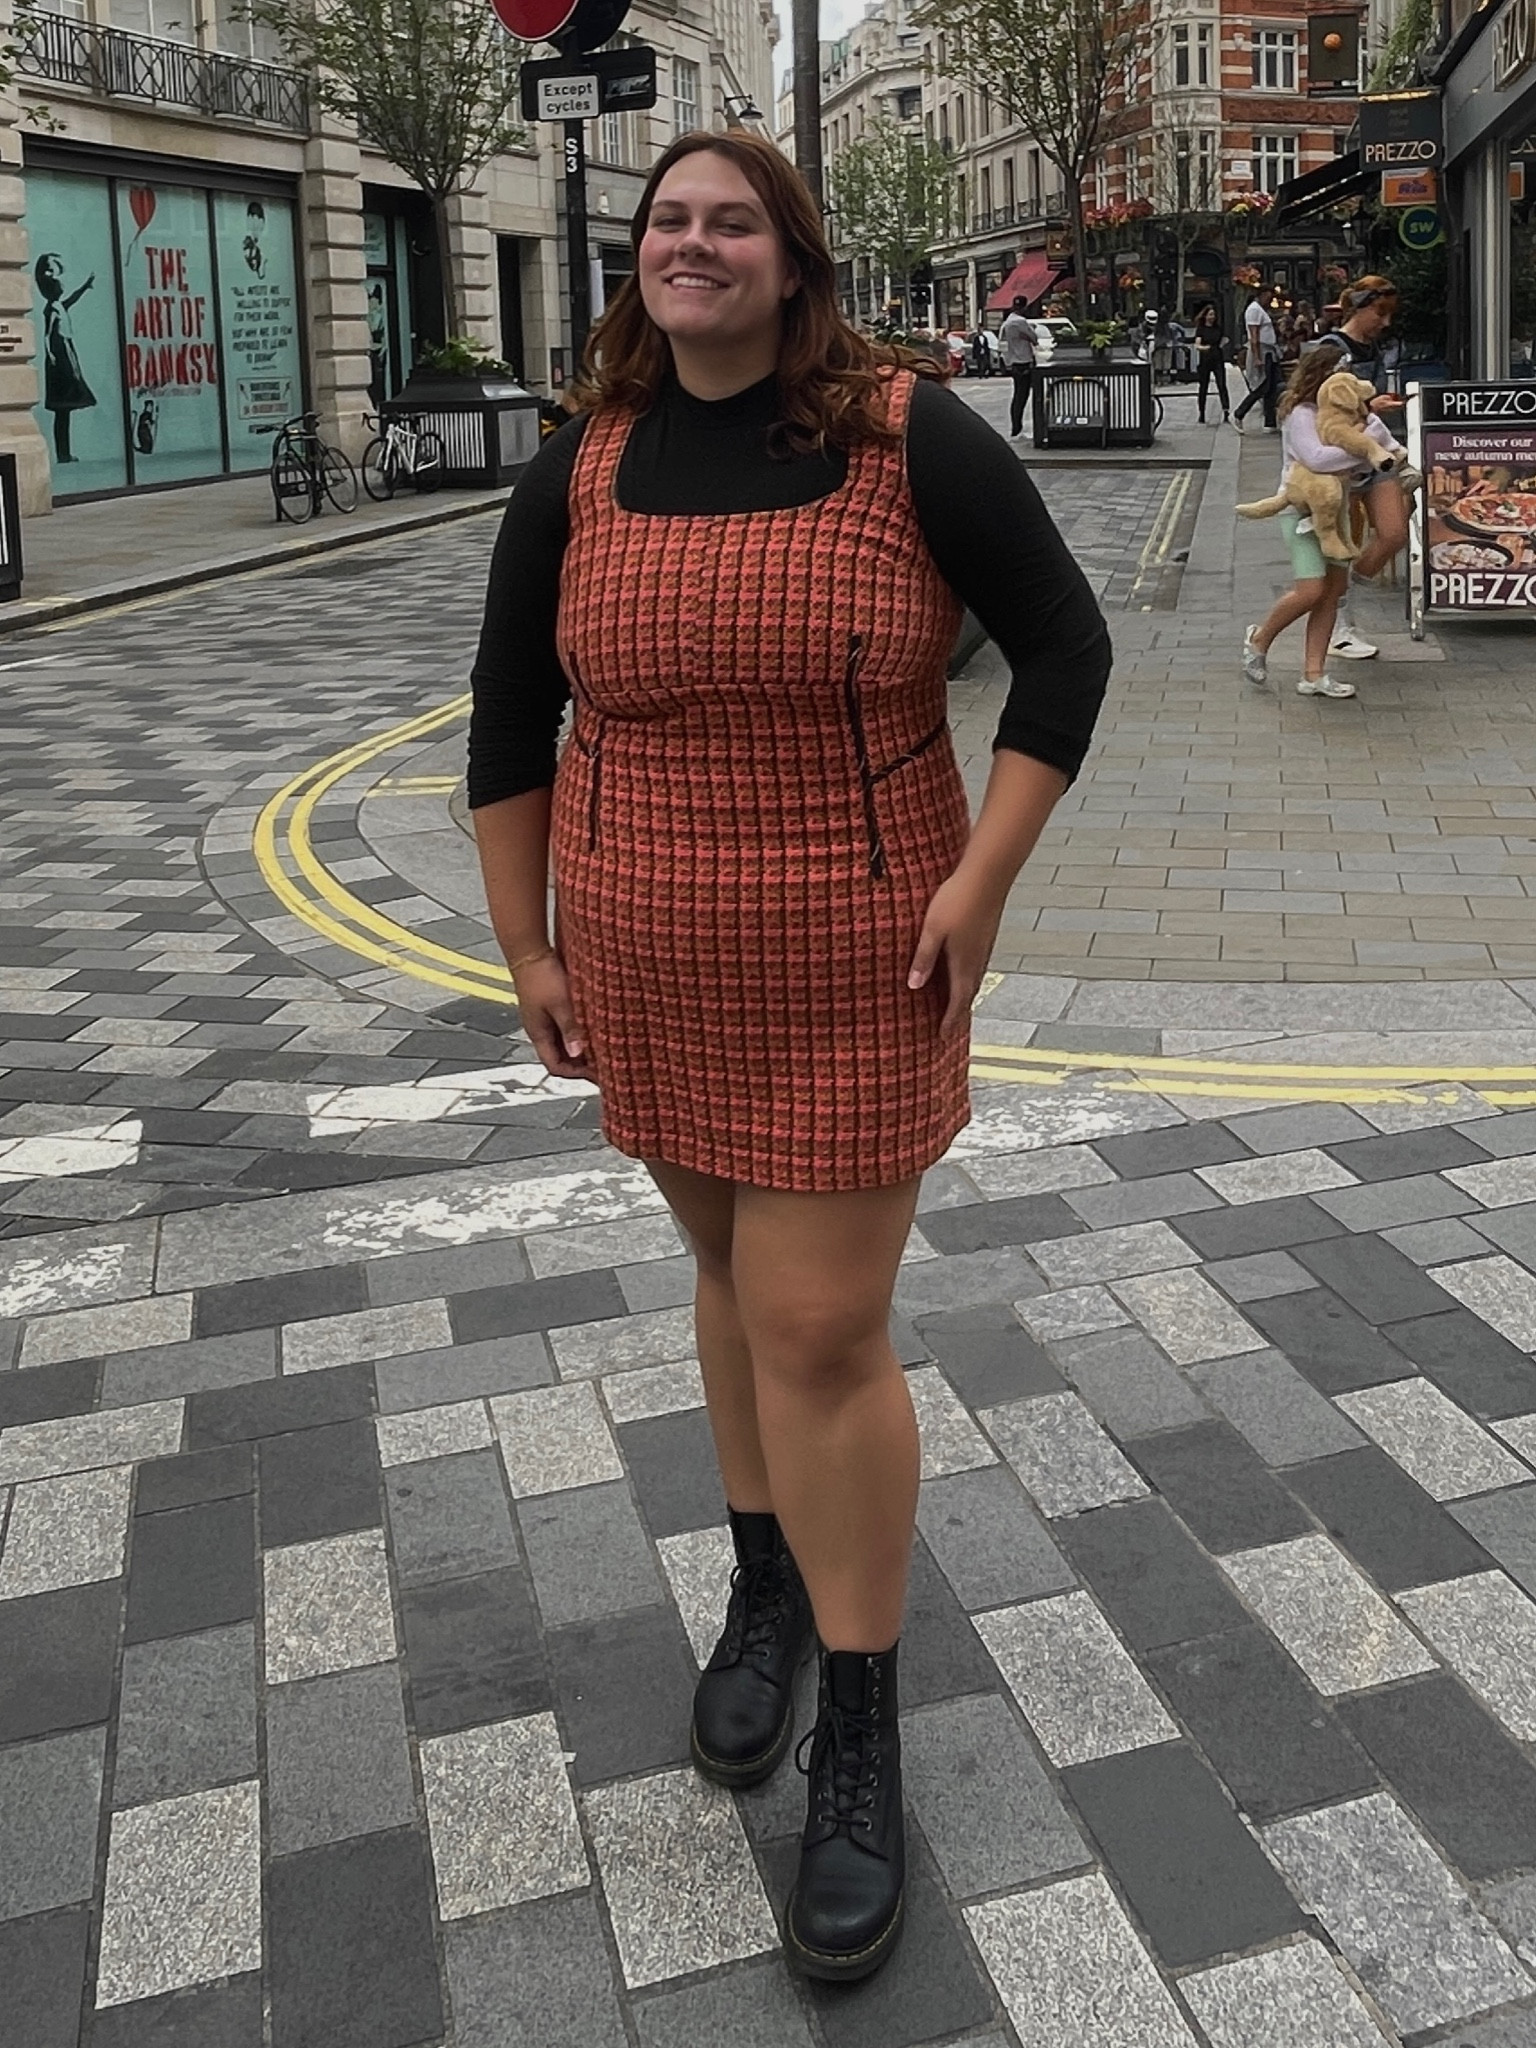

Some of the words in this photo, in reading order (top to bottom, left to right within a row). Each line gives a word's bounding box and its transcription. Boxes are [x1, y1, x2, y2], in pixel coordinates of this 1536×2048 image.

[544, 82, 593, 97] Except
[546, 100, 590, 114] cycles
[1365, 140, 1437, 163] PREZZO
[145, 247, 189, 293] THE
[134, 296, 175, 341] ART
[181, 297, 205, 339] OF
[127, 343, 217, 390] BANKSY
[1443, 390, 1536, 415] PREZZO
[1452, 435, 1508, 448] Discover
[1510, 438, 1533, 447] our
[1434, 451, 1462, 461] new
[1464, 451, 1513, 461] autumn
